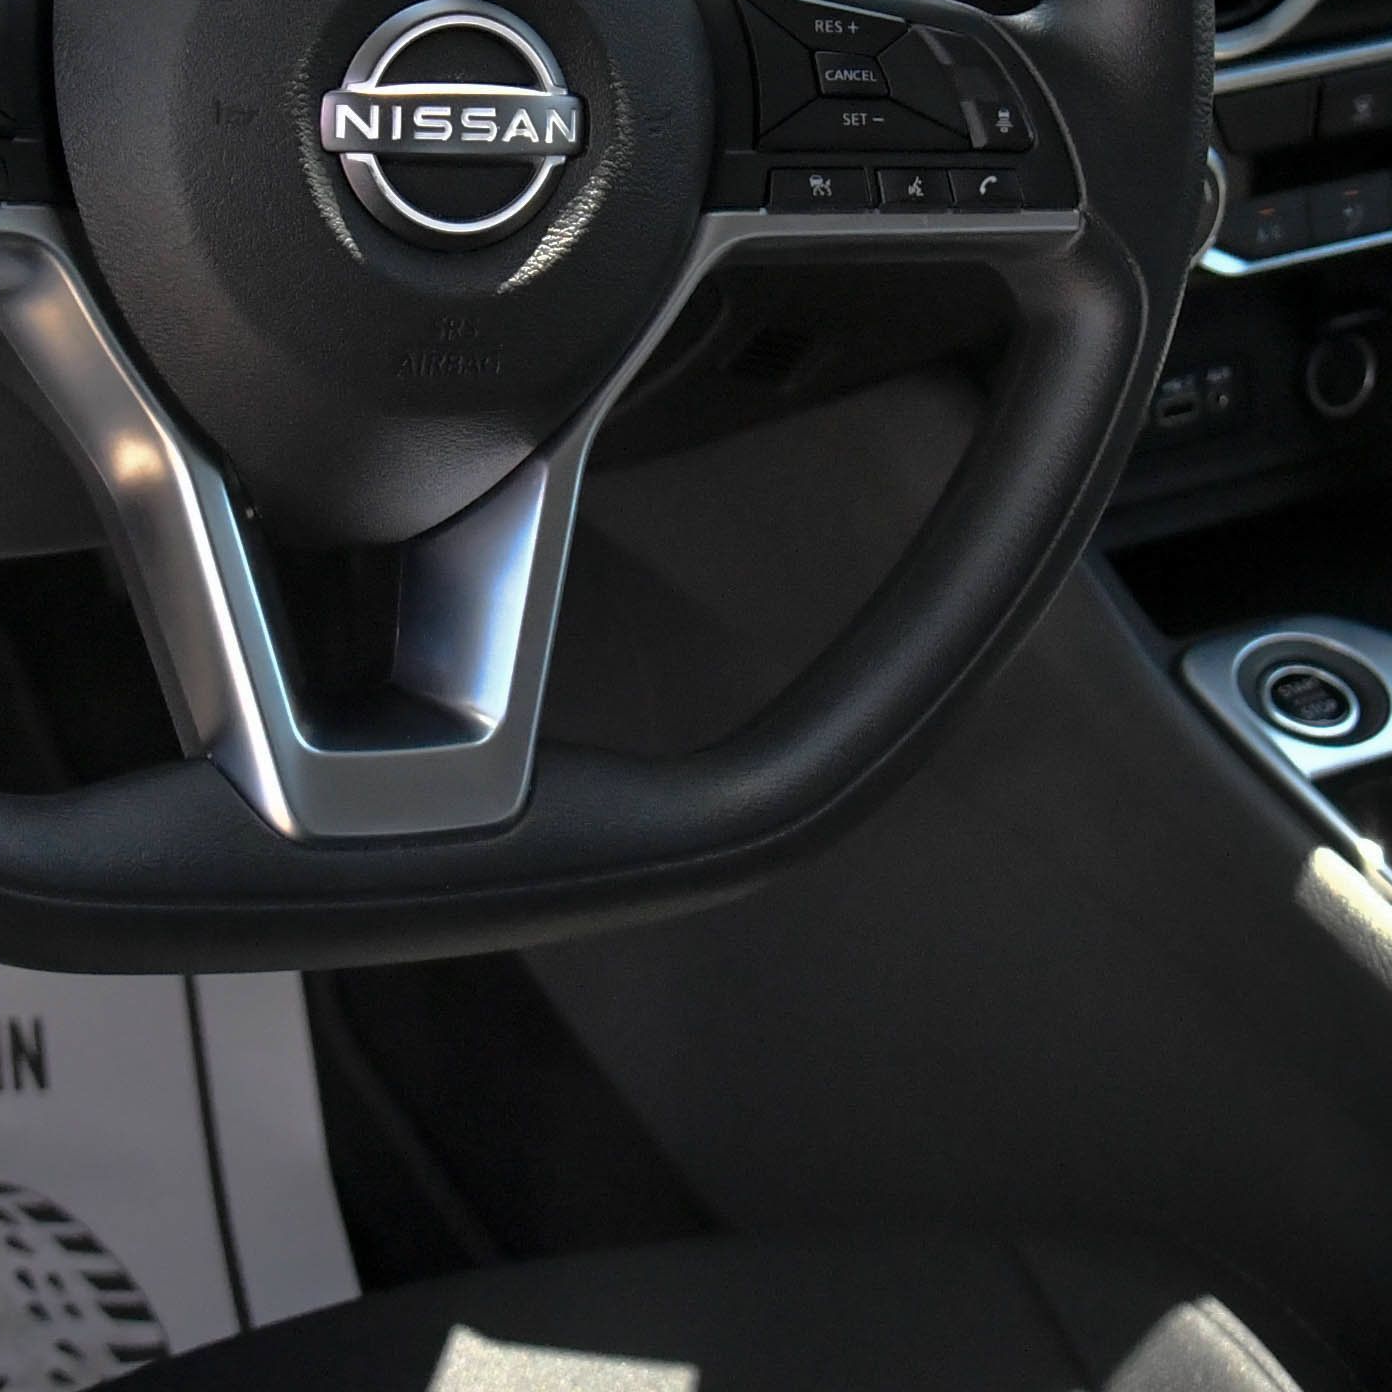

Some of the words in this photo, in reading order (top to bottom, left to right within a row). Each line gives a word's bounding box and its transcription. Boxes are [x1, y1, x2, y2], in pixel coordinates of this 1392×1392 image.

[814, 19, 843, 34] RES
[824, 69, 877, 82] CANCEL
[334, 103, 577, 144] NISSAN
[842, 113, 867, 127] SET
